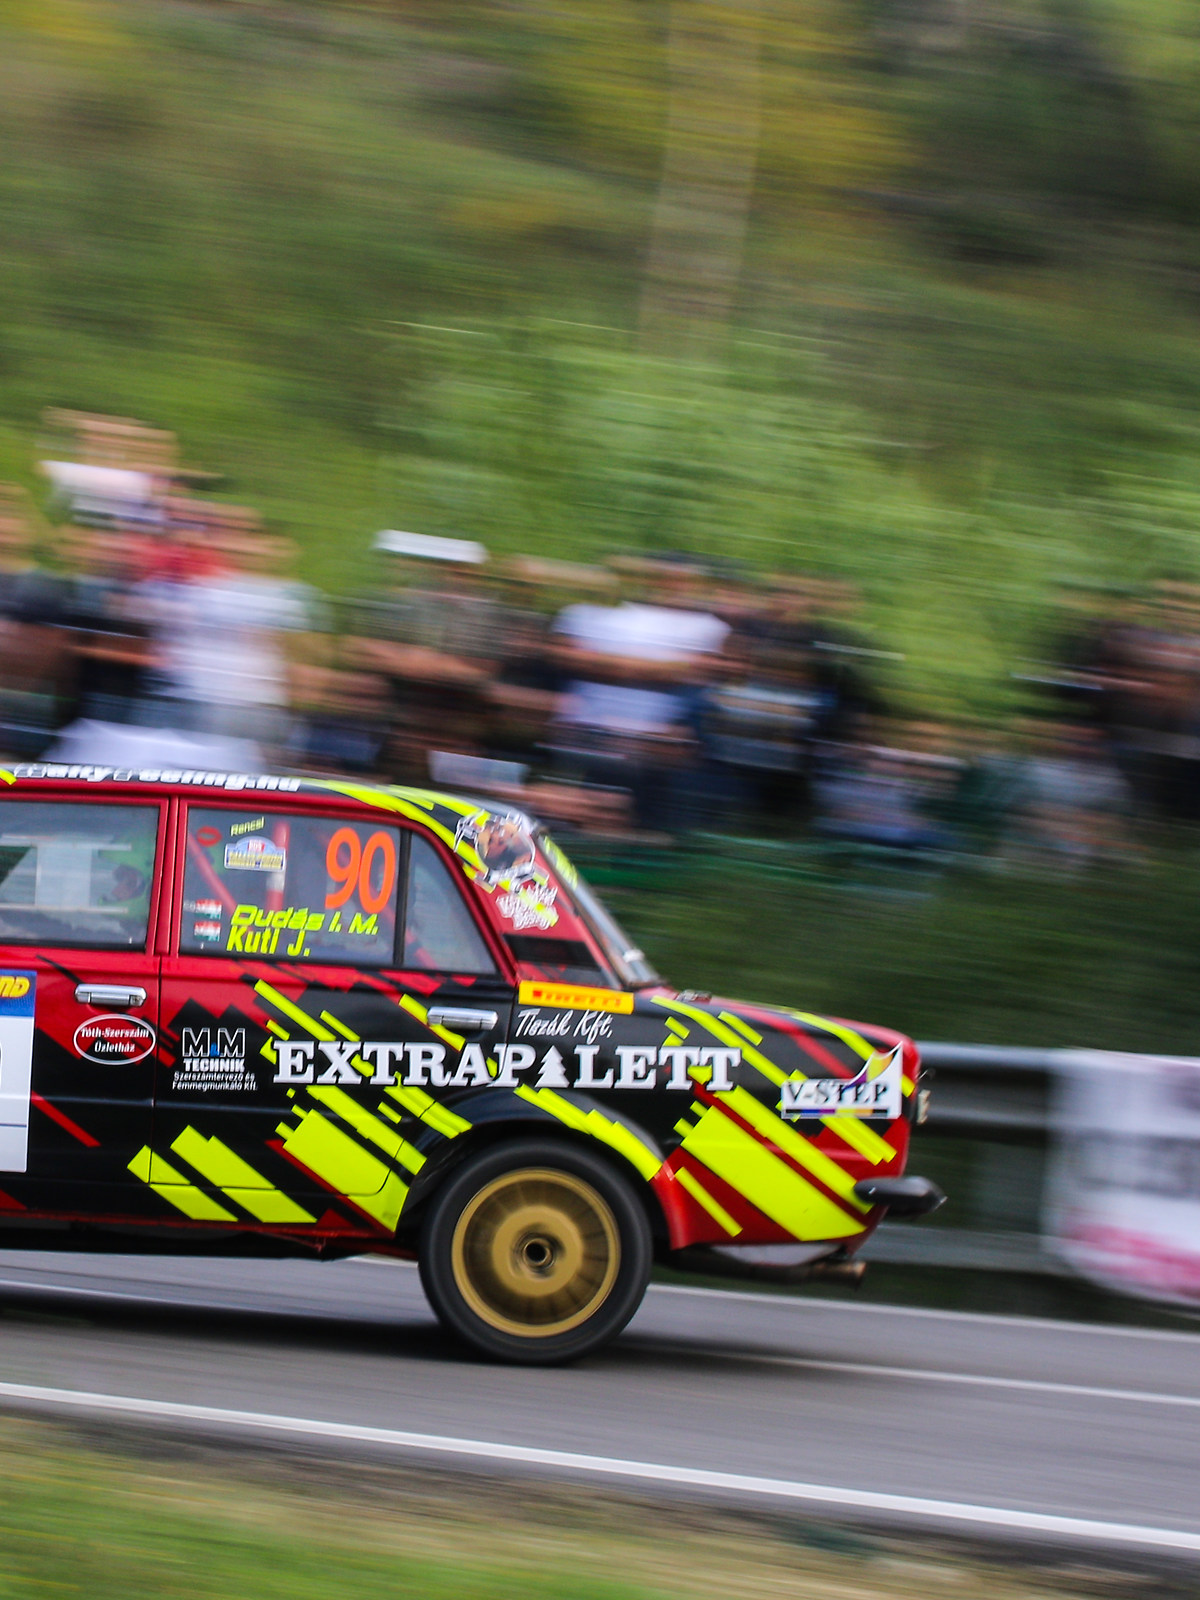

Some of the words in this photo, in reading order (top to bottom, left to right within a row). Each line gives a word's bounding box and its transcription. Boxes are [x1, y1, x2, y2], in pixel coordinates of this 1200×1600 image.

[324, 827, 396, 914] 90
[230, 904, 326, 931] Dudás
[348, 912, 379, 935] M.
[226, 925, 281, 954] Kuti
[287, 929, 311, 957] J.
[183, 1058, 246, 1073] TECHNIK
[788, 1080, 888, 1103] V-STEP
